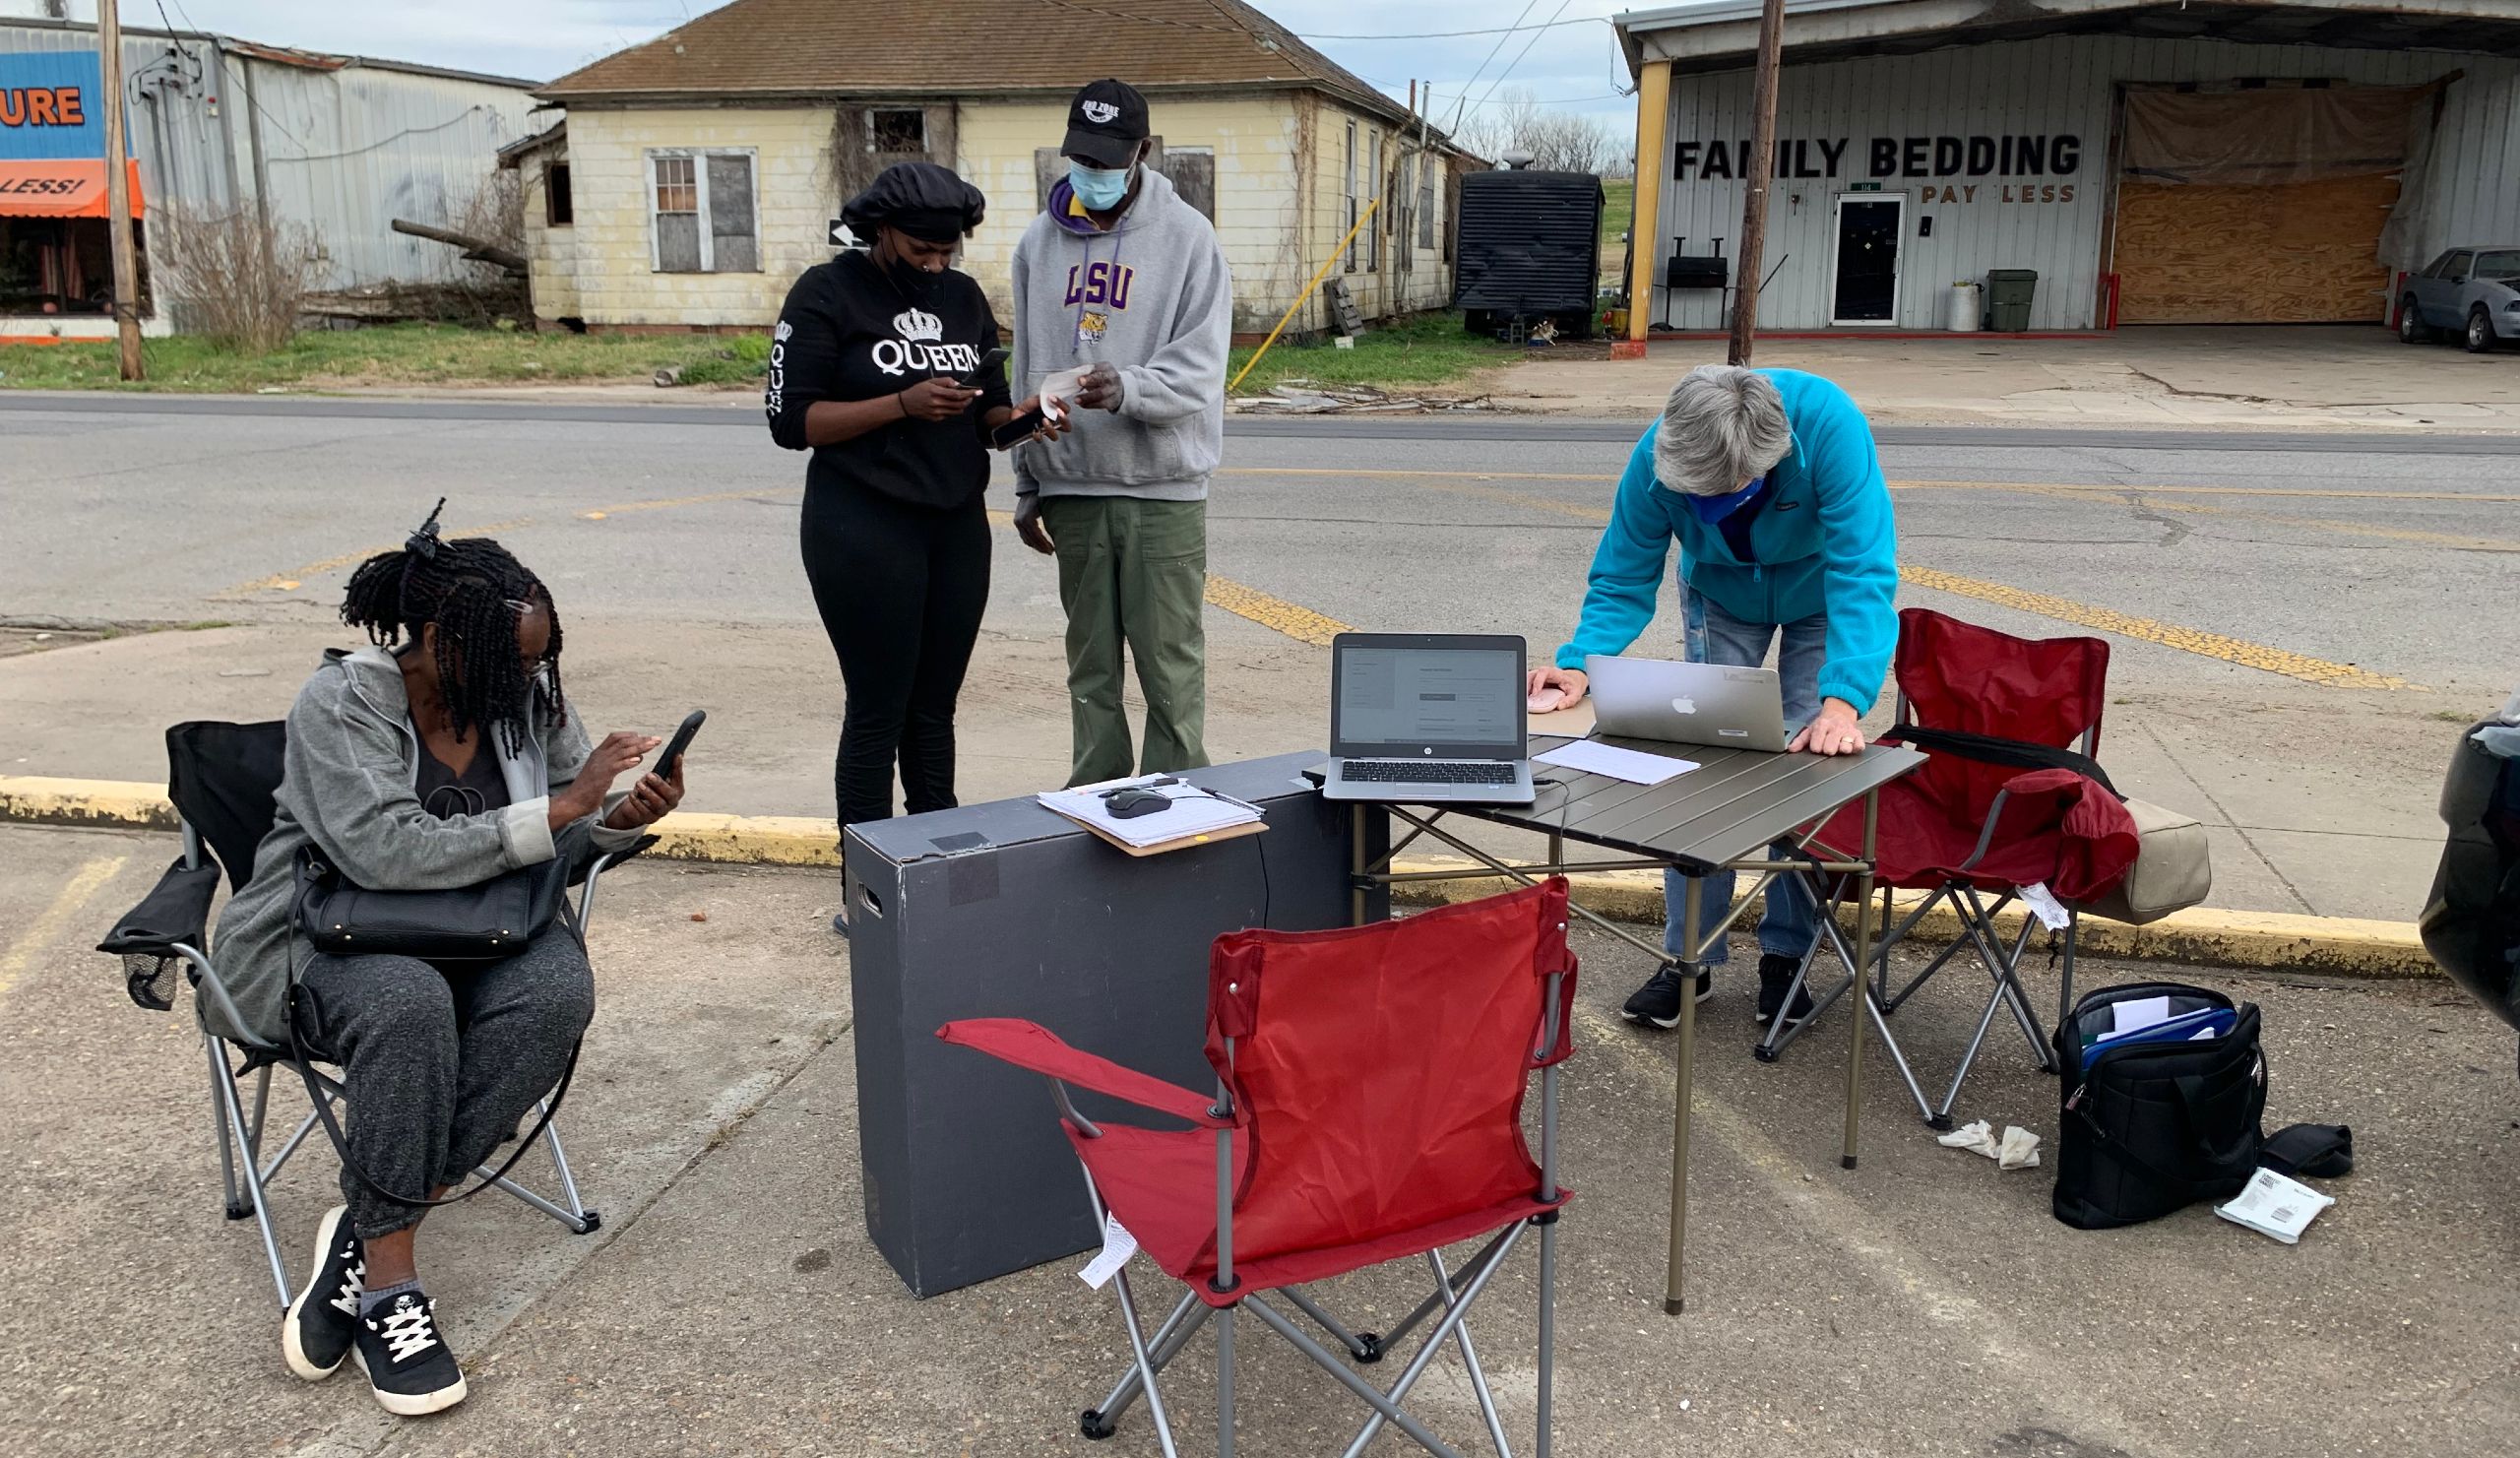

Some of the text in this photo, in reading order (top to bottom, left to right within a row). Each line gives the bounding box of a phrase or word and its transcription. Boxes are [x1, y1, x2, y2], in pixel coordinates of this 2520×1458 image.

[0, 87, 85, 127] URE
[1870, 135, 2080, 177] BEDDING
[0, 178, 86, 194] LESS!
[1922, 185, 2075, 203] PAY LESS
[1063, 261, 1135, 311] LSU
[871, 339, 979, 375] QUEEN
